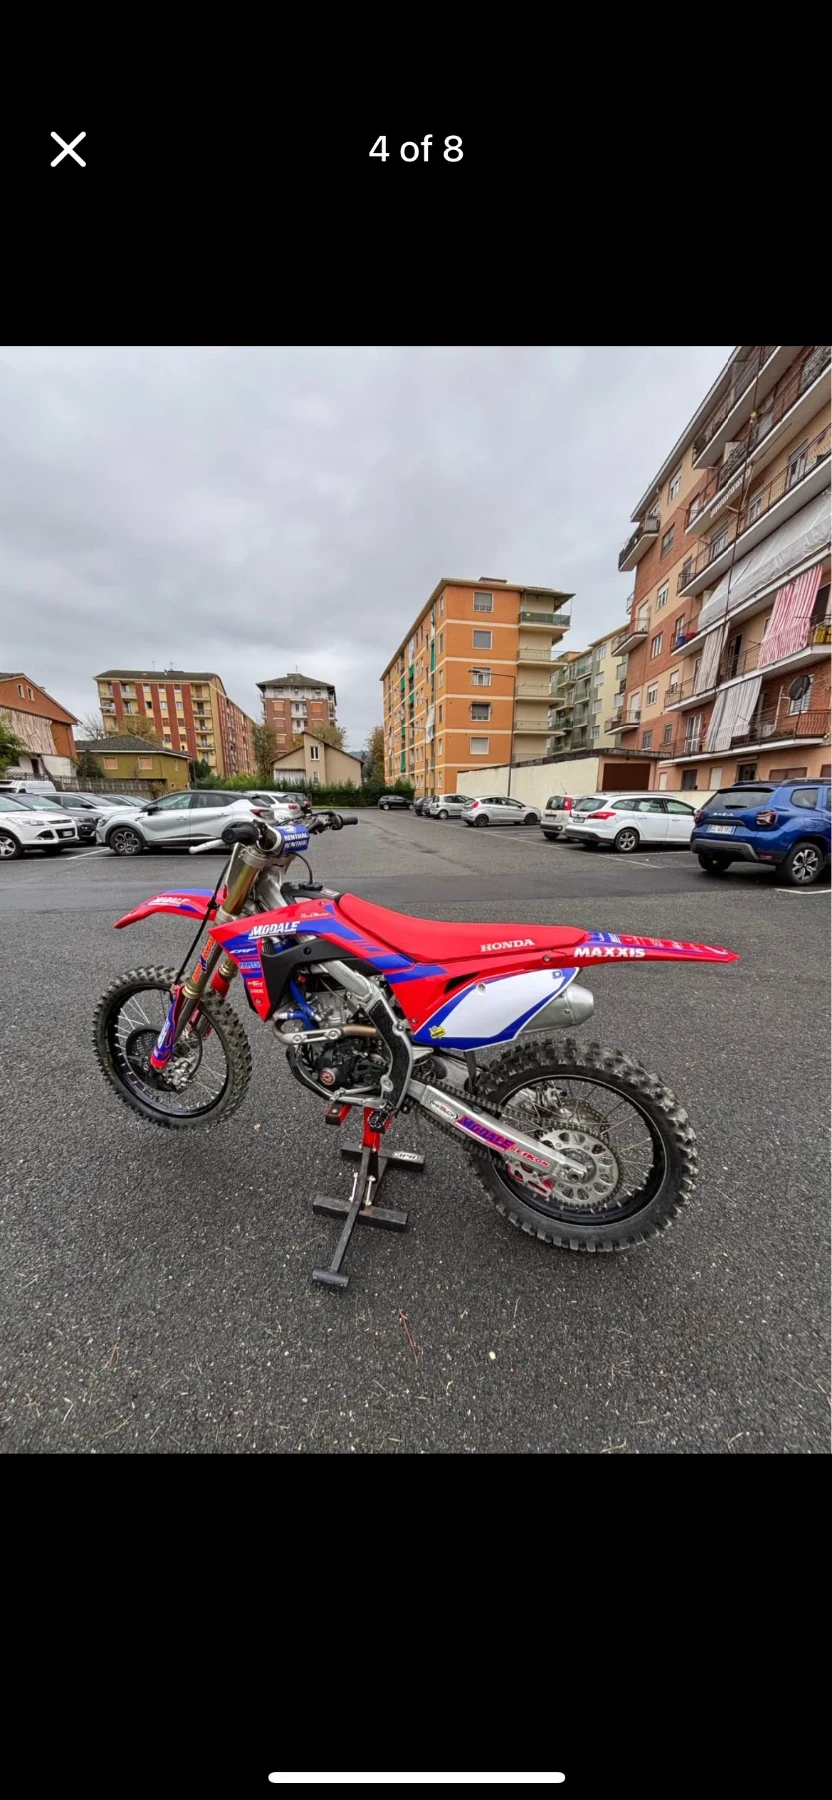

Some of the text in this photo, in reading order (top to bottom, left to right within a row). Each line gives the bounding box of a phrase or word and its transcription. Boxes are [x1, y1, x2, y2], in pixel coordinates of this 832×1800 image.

[283, 832, 309, 841] RENTHAL
[248, 921, 300, 939] MODALE
[480, 938, 535, 952] HONDA
[573, 947, 646, 958] MAXXIS
[456, 1115, 515, 1152] MODALE
